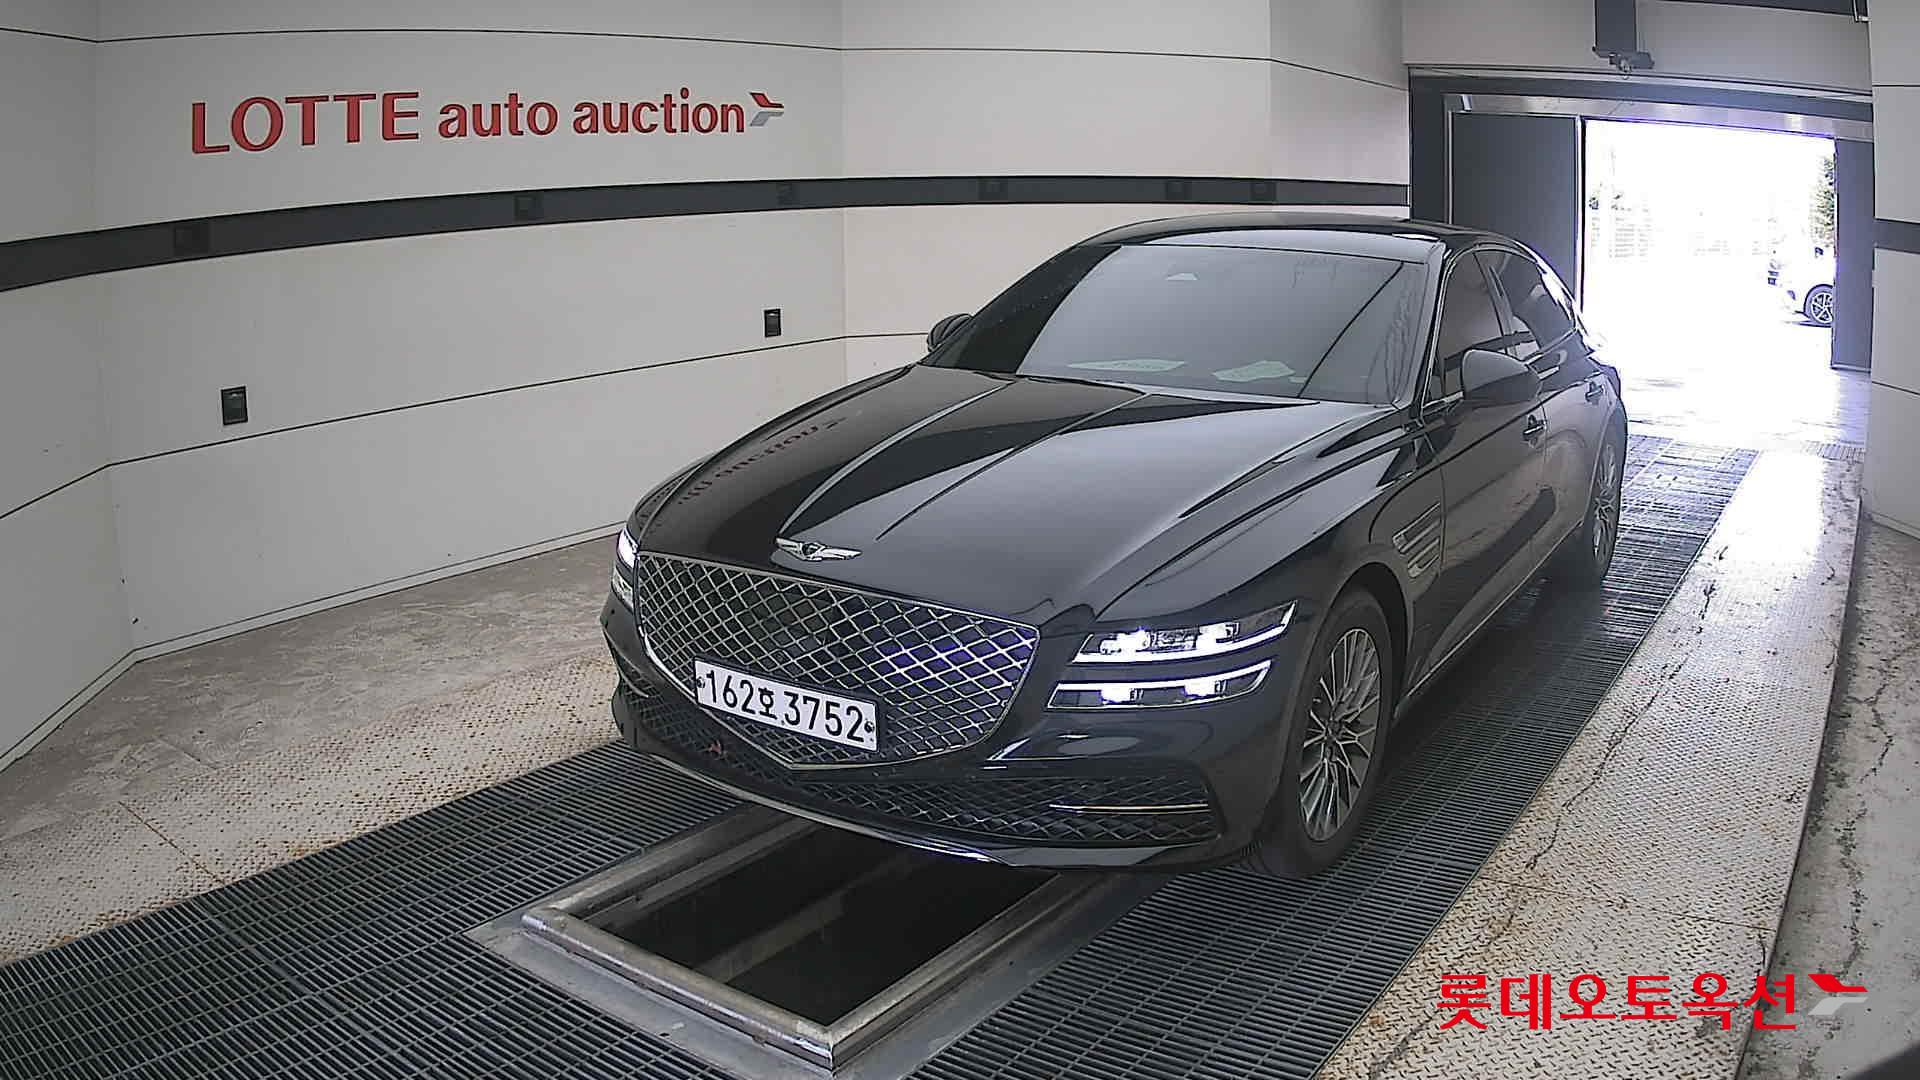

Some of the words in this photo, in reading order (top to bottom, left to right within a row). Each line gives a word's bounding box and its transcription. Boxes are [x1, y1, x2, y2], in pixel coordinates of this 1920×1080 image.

[190, 91, 420, 154] LOTTE
[438, 92, 559, 138] auto
[573, 87, 746, 135] auction
[784, 690, 865, 743] 3752
